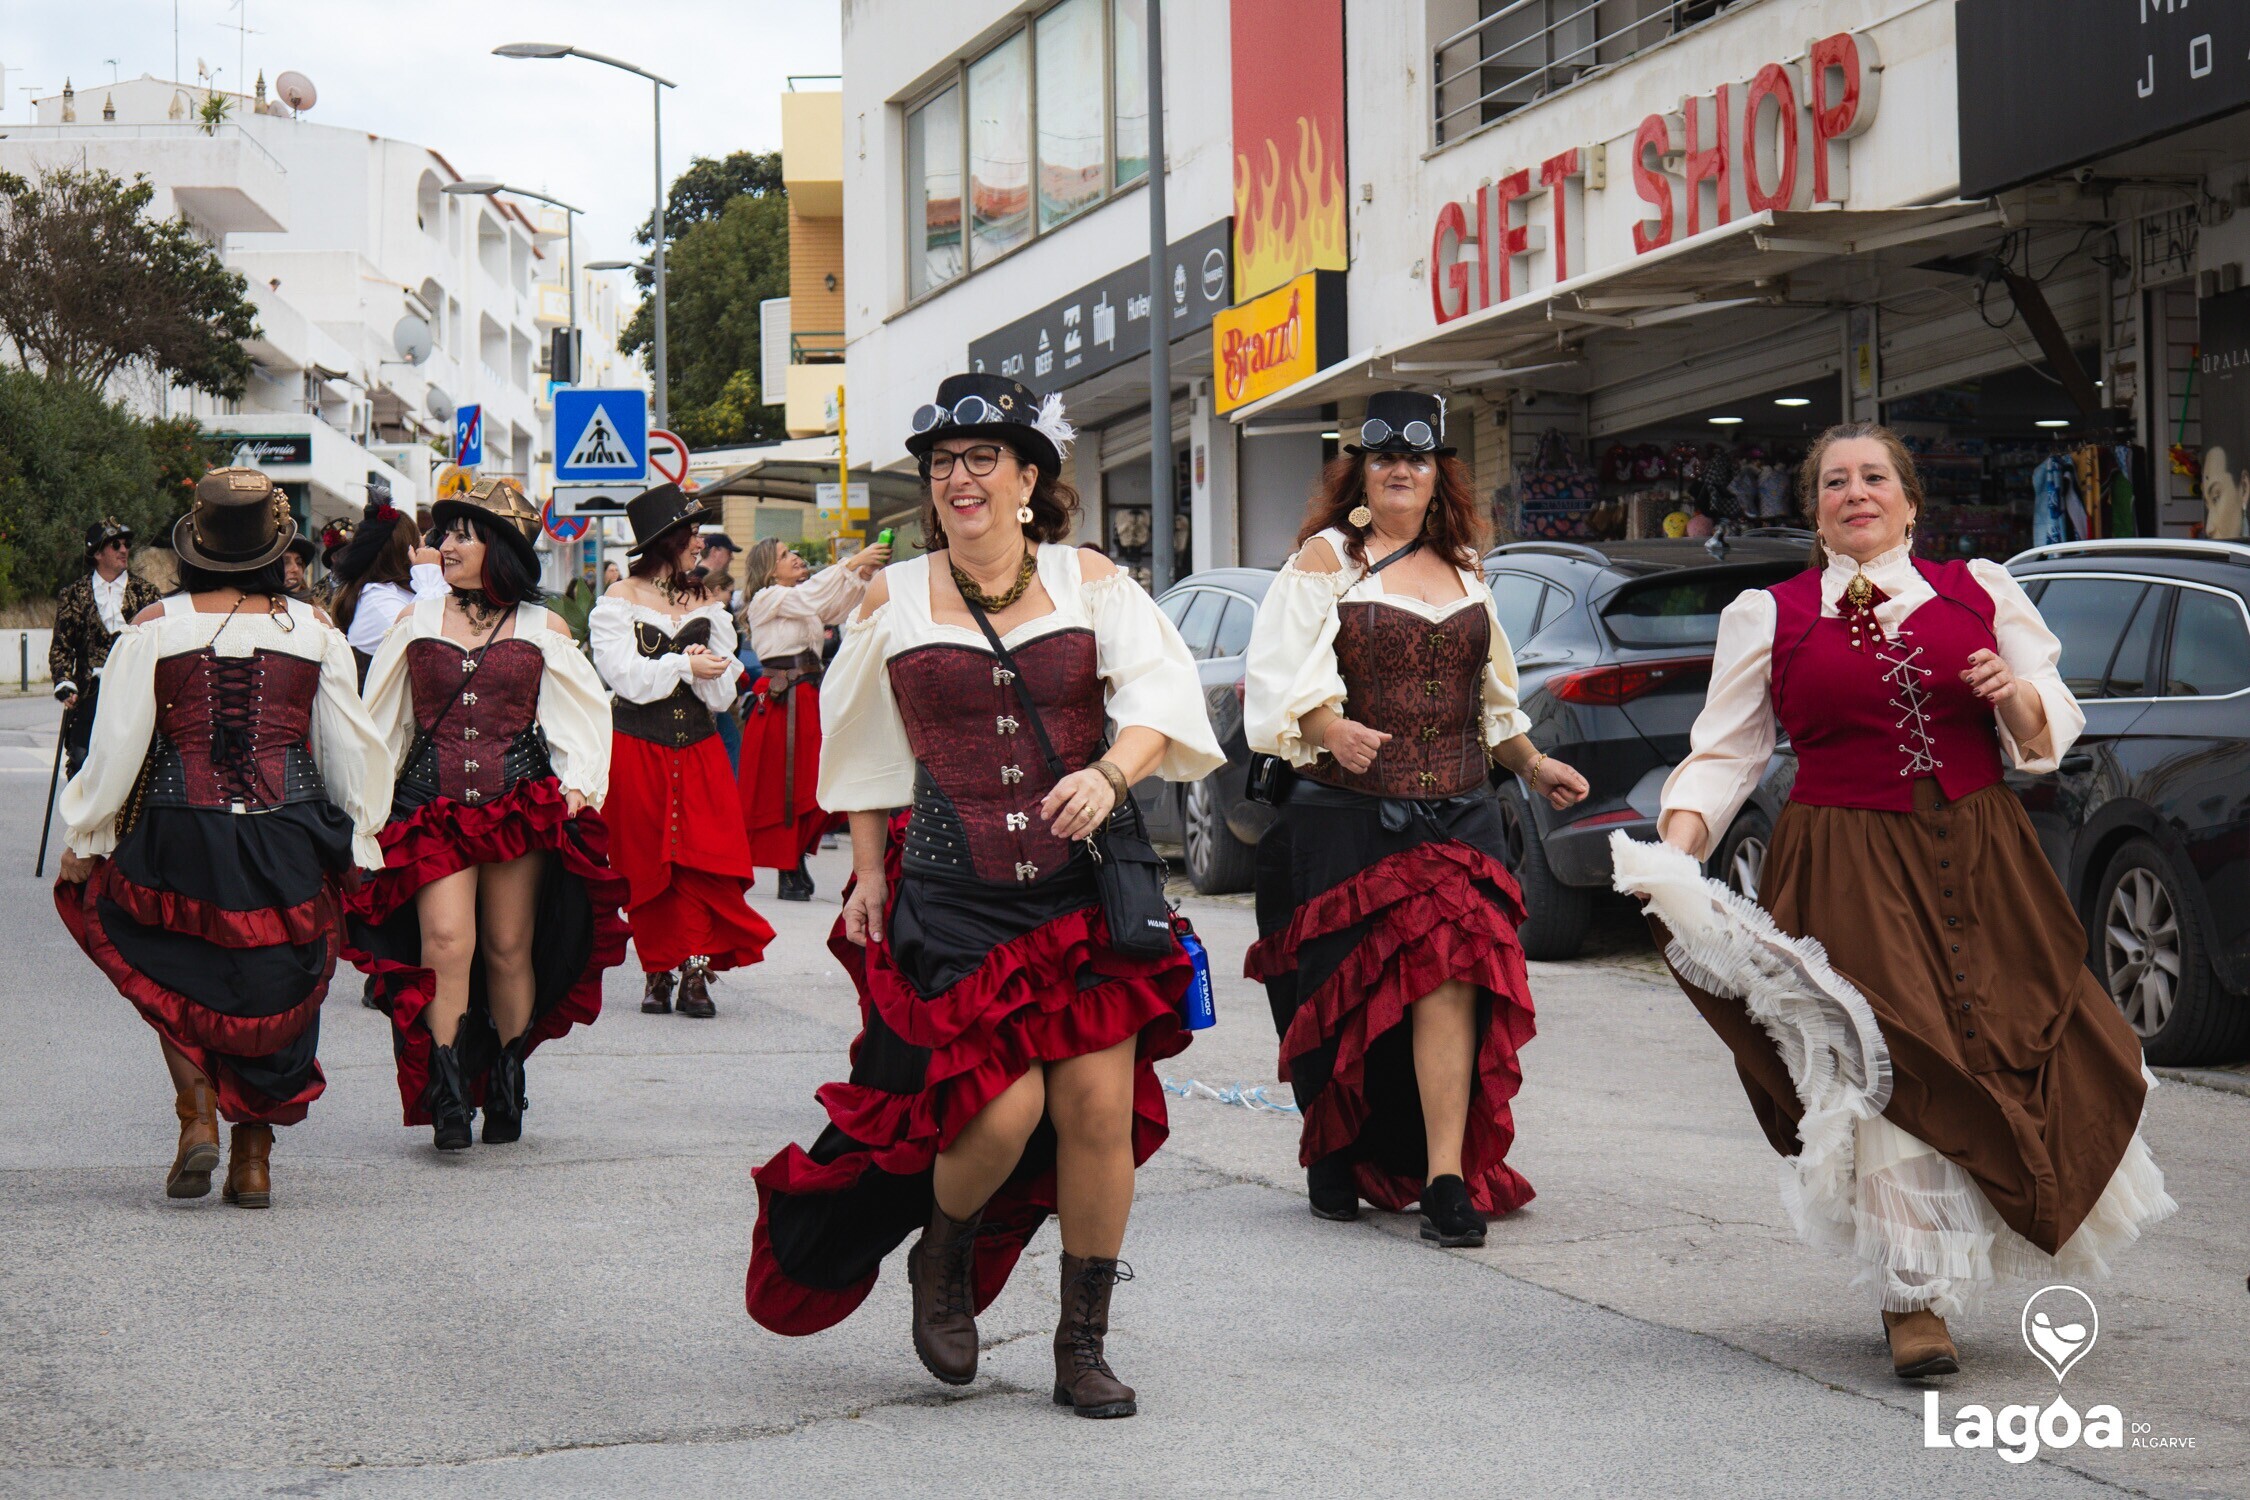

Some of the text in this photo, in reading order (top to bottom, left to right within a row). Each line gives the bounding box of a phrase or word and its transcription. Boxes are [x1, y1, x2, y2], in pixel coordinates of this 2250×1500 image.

[2137, 33, 2250, 98] JO
[1432, 32, 1876, 324] GIFT SHOP
[459, 420, 479, 450] 30
[1201, 969, 1211, 1015] ODIVELAS
